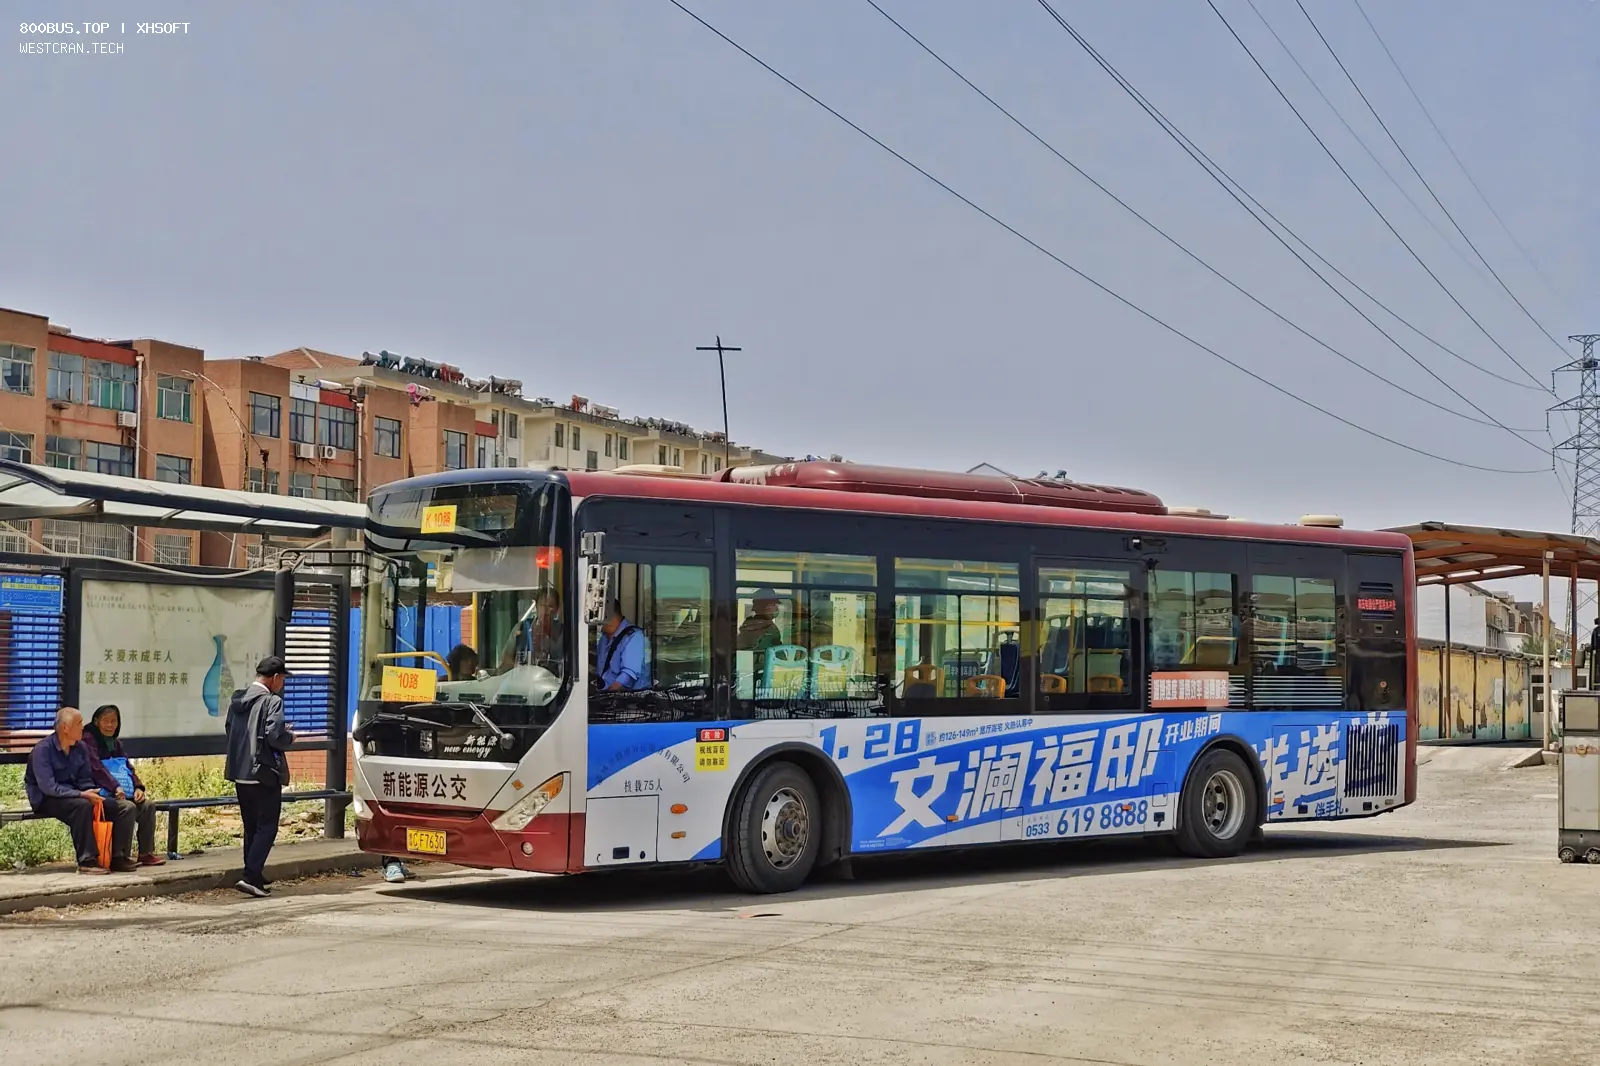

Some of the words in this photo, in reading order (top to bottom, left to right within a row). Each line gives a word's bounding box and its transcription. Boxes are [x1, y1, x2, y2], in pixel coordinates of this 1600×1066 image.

[104, 649, 173, 663] 关爱未成年人
[84, 671, 188, 685] 就是关注祖国的未来
[1165, 714, 1222, 745] 开业期间
[464, 734, 498, 747] 新能源
[443, 745, 461, 753] new
[462, 745, 493, 758] energy
[382, 771, 467, 801] 新能源公交
[1026, 822, 1050, 837] 0533
[1056, 806, 1096, 835] 619
[1099, 799, 1149, 830] 8888
